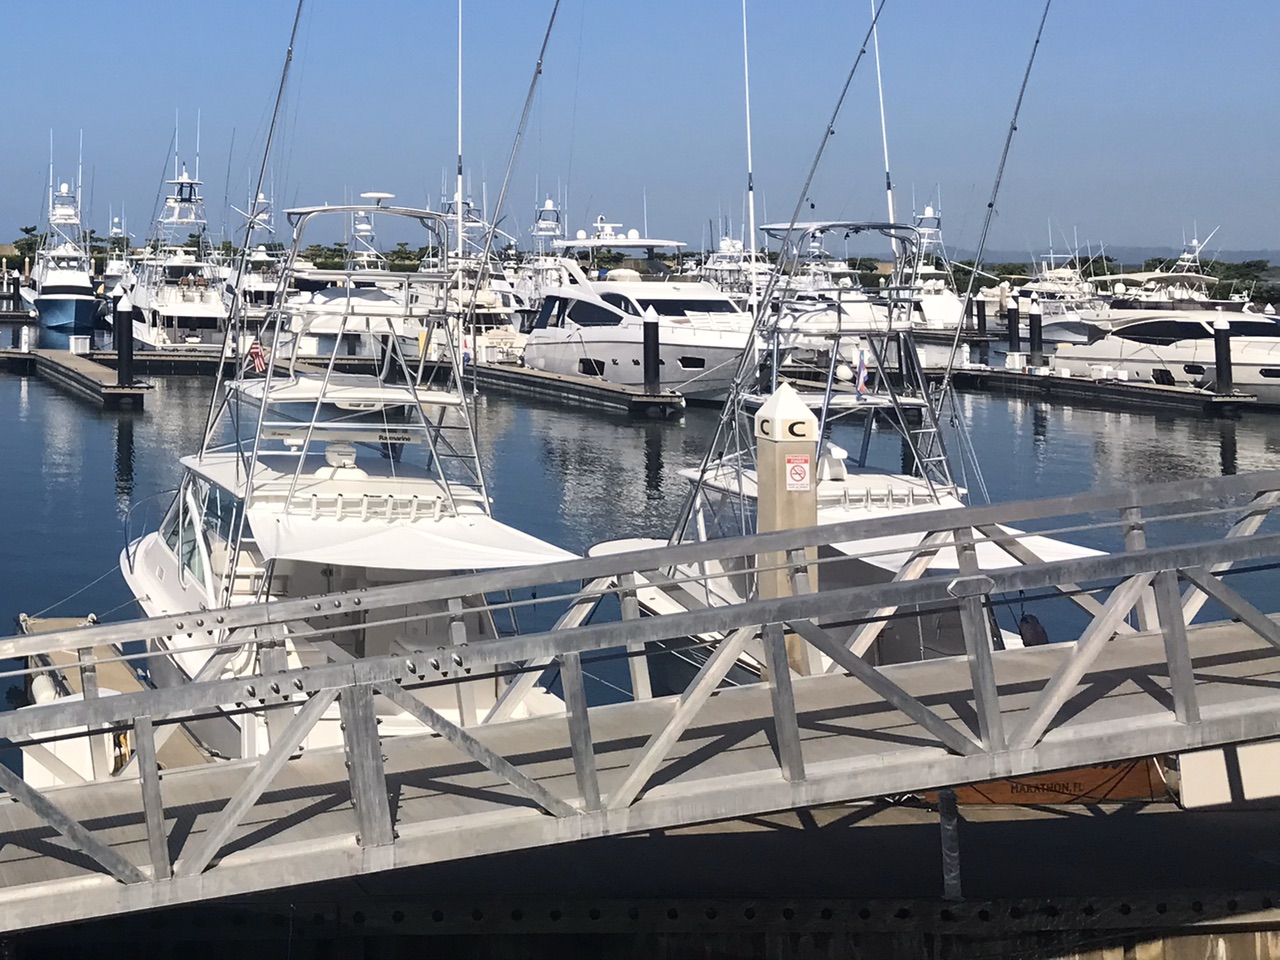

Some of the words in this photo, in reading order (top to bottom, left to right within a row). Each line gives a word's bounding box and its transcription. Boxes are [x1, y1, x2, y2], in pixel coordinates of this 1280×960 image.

[760, 419, 770, 435] C
[788, 421, 807, 438] C
[378, 434, 411, 443] Ramarine
